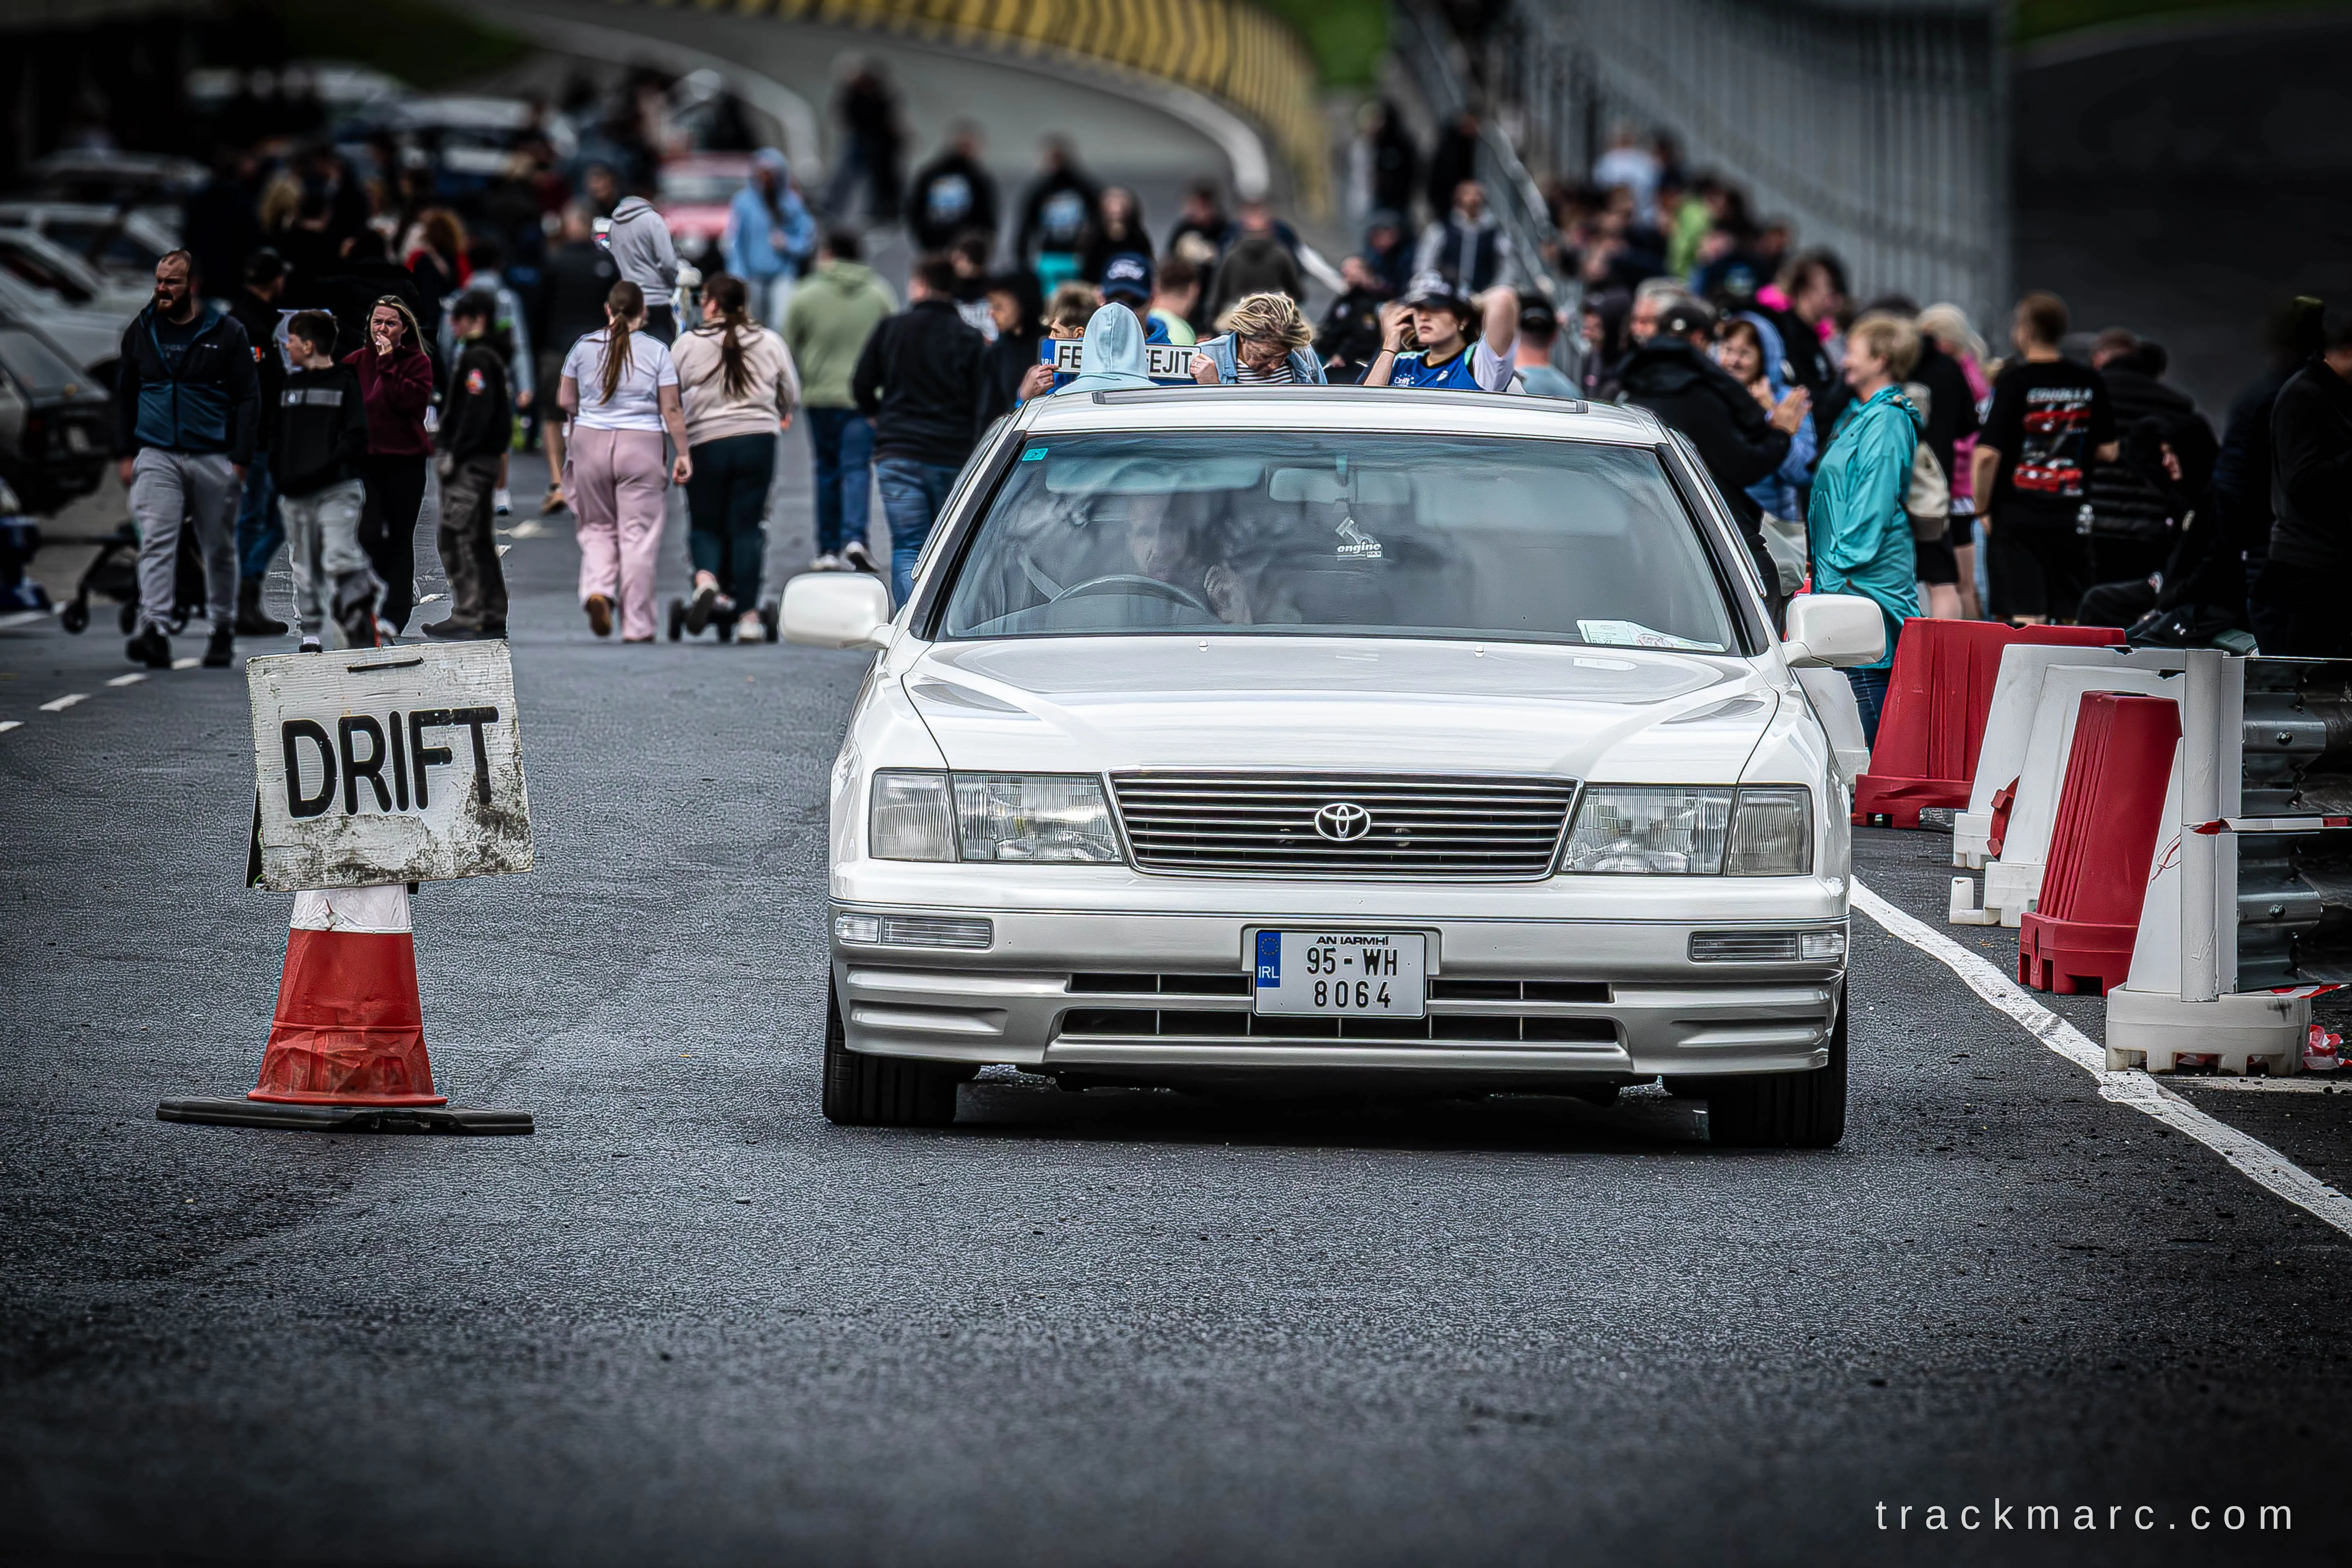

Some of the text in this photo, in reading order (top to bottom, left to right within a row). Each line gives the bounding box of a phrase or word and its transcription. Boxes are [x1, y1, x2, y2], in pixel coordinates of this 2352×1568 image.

[281, 707, 499, 819] DRIFT
[1316, 936, 1337, 945] AN
[1258, 966, 1280, 979] IRL
[1314, 980, 1391, 1008] 8064
